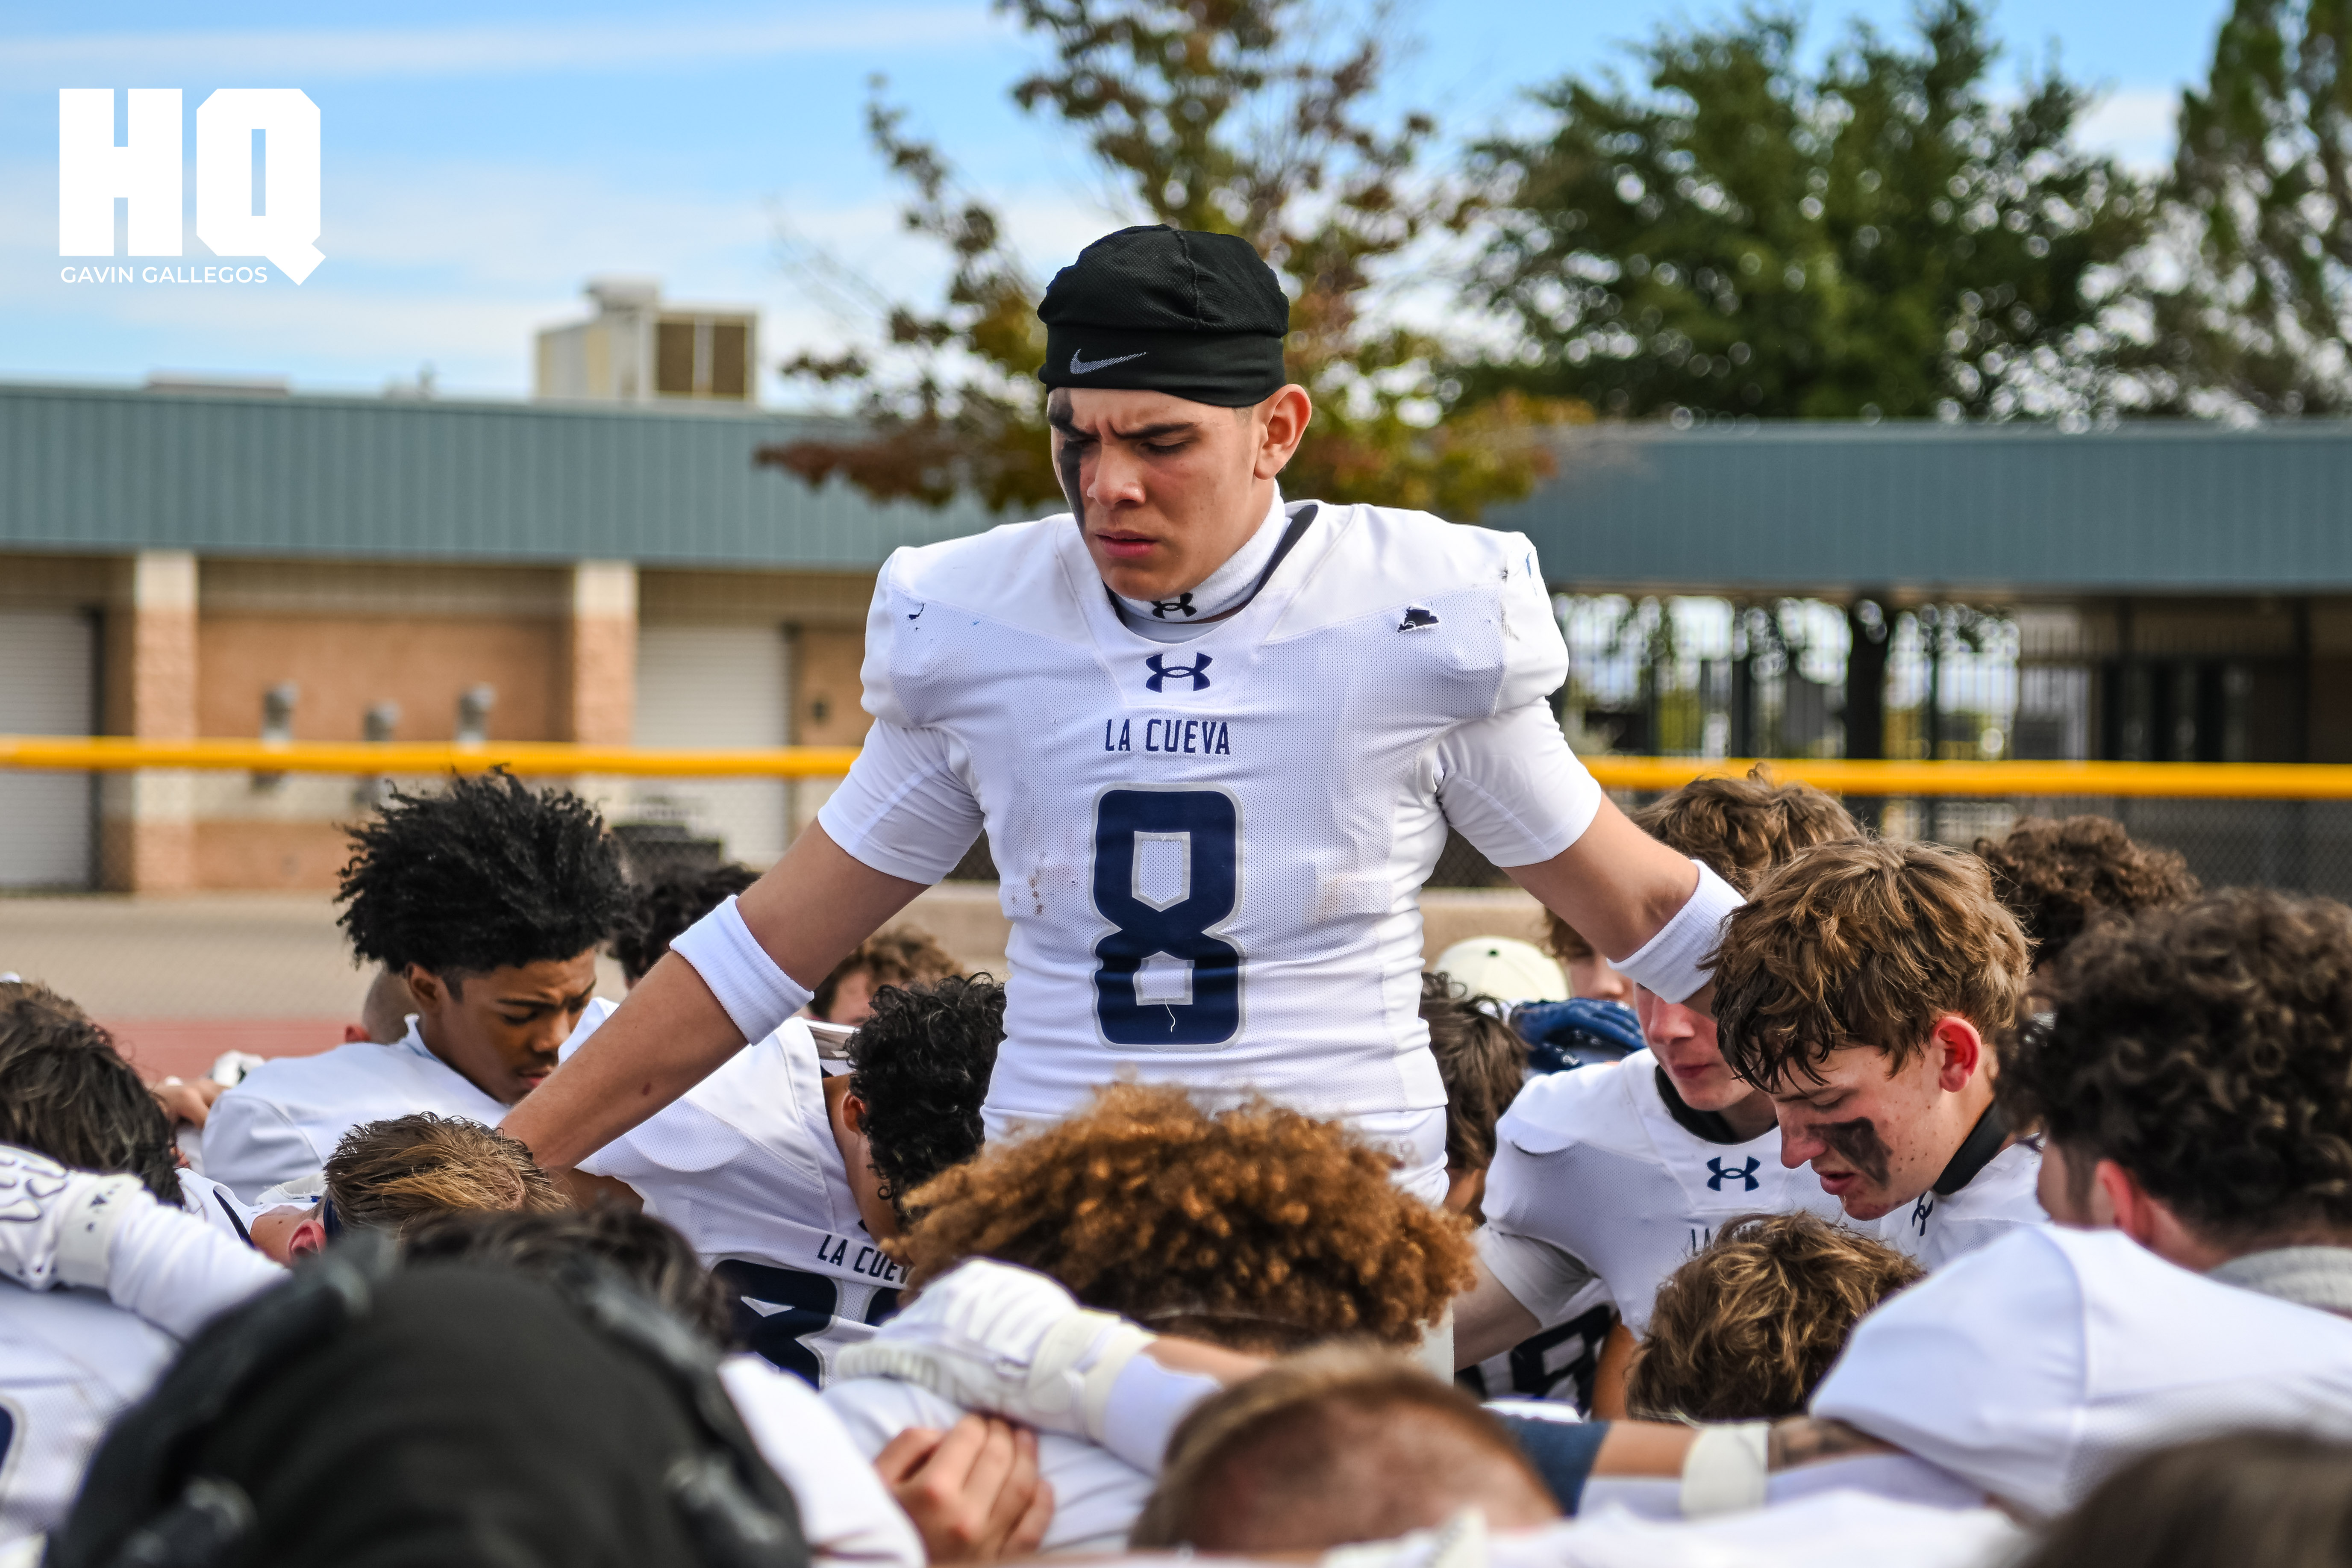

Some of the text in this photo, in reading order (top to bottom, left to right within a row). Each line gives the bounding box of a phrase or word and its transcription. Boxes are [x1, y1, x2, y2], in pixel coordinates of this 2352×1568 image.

[1105, 719, 1231, 755] LA CUEVA
[1089, 783, 1247, 1050] 8
[817, 1234, 914, 1284] LA CUEV
